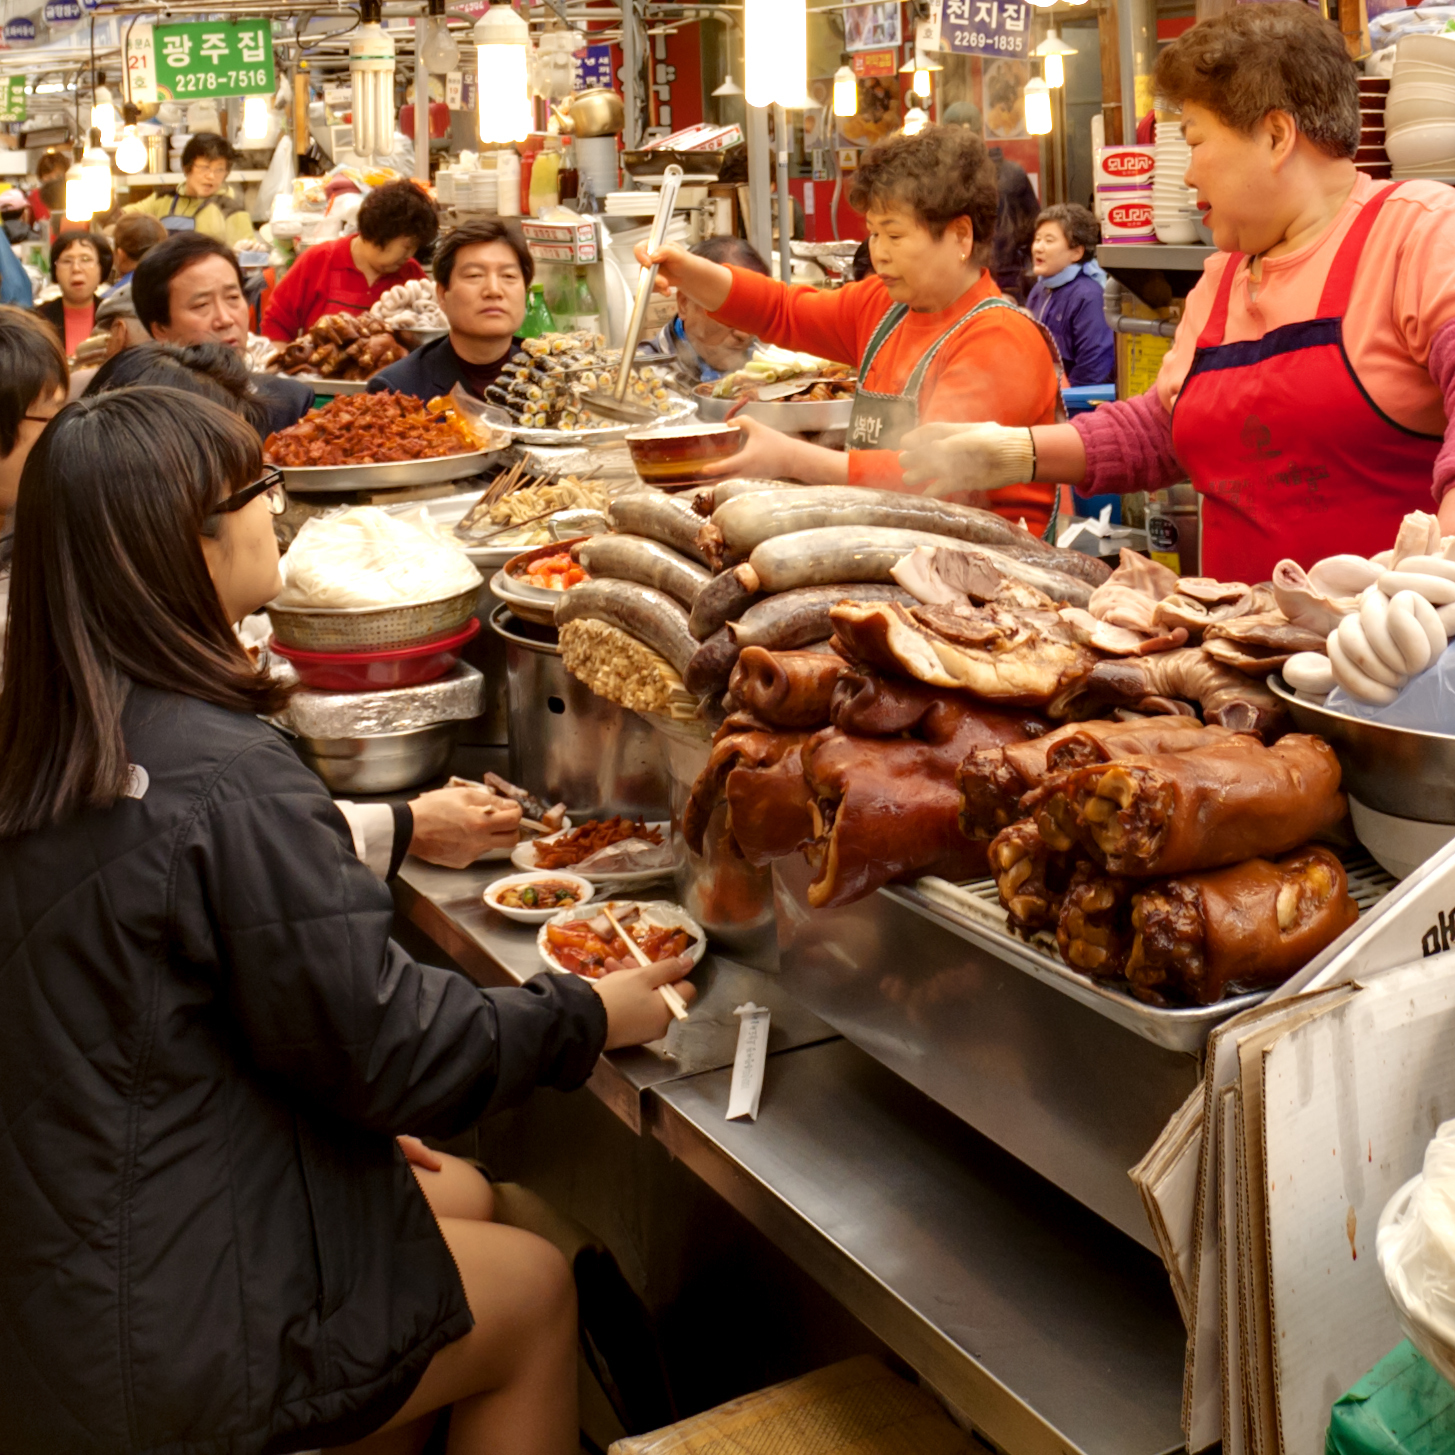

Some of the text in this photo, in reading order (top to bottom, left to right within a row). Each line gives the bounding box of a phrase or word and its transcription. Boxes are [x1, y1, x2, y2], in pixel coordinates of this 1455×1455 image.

[162, 29, 266, 68] 광주집
[954, 31, 1023, 52] 2269-1835
[129, 55, 147, 70] 21
[175, 69, 267, 92] 2278-7516
